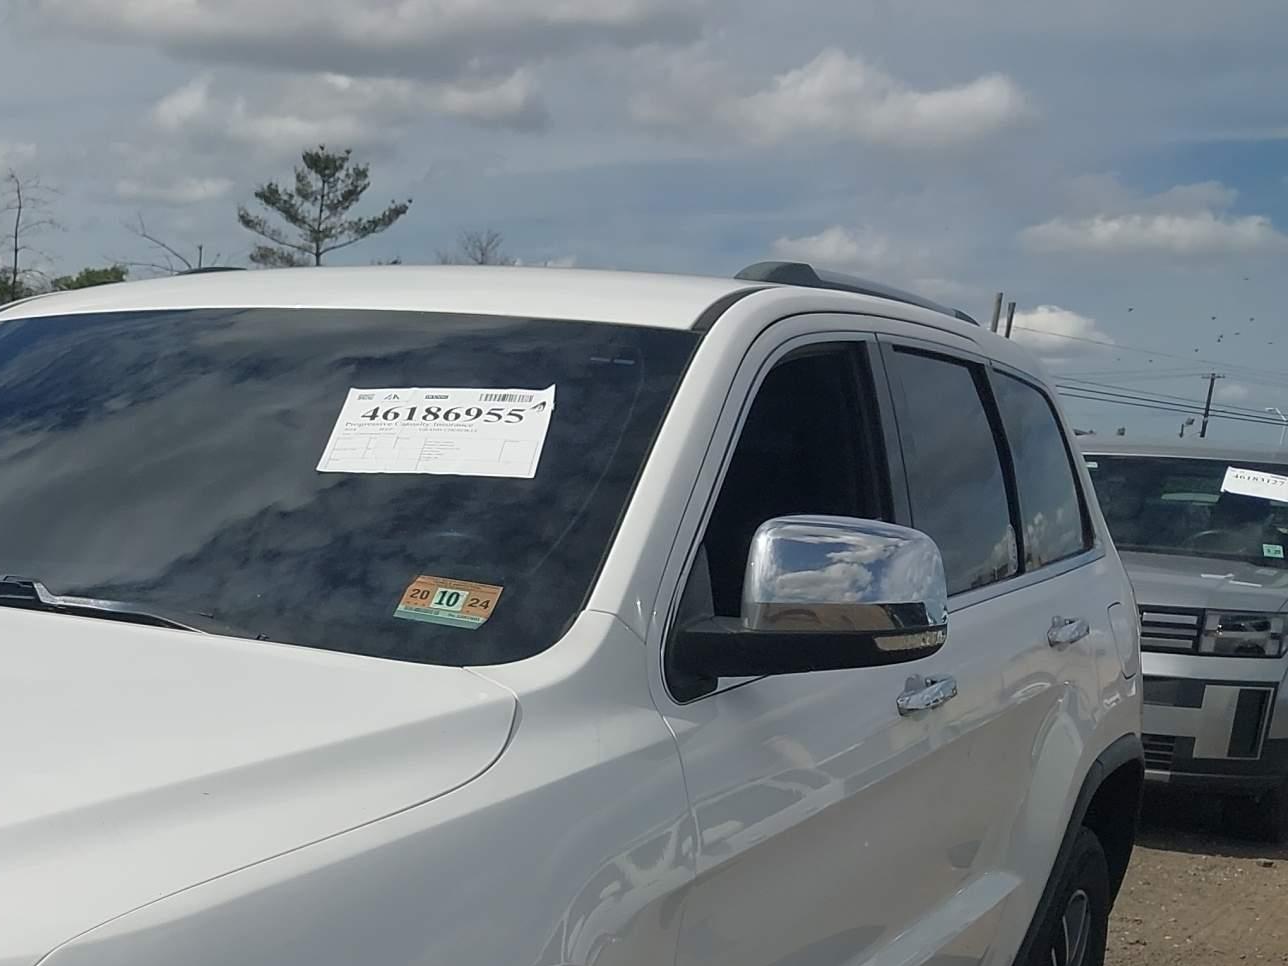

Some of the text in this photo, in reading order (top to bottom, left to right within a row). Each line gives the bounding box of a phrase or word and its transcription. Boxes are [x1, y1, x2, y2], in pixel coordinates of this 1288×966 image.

[360, 406, 526, 423] 46186955
[410, 588, 490, 610] 20 10 24
